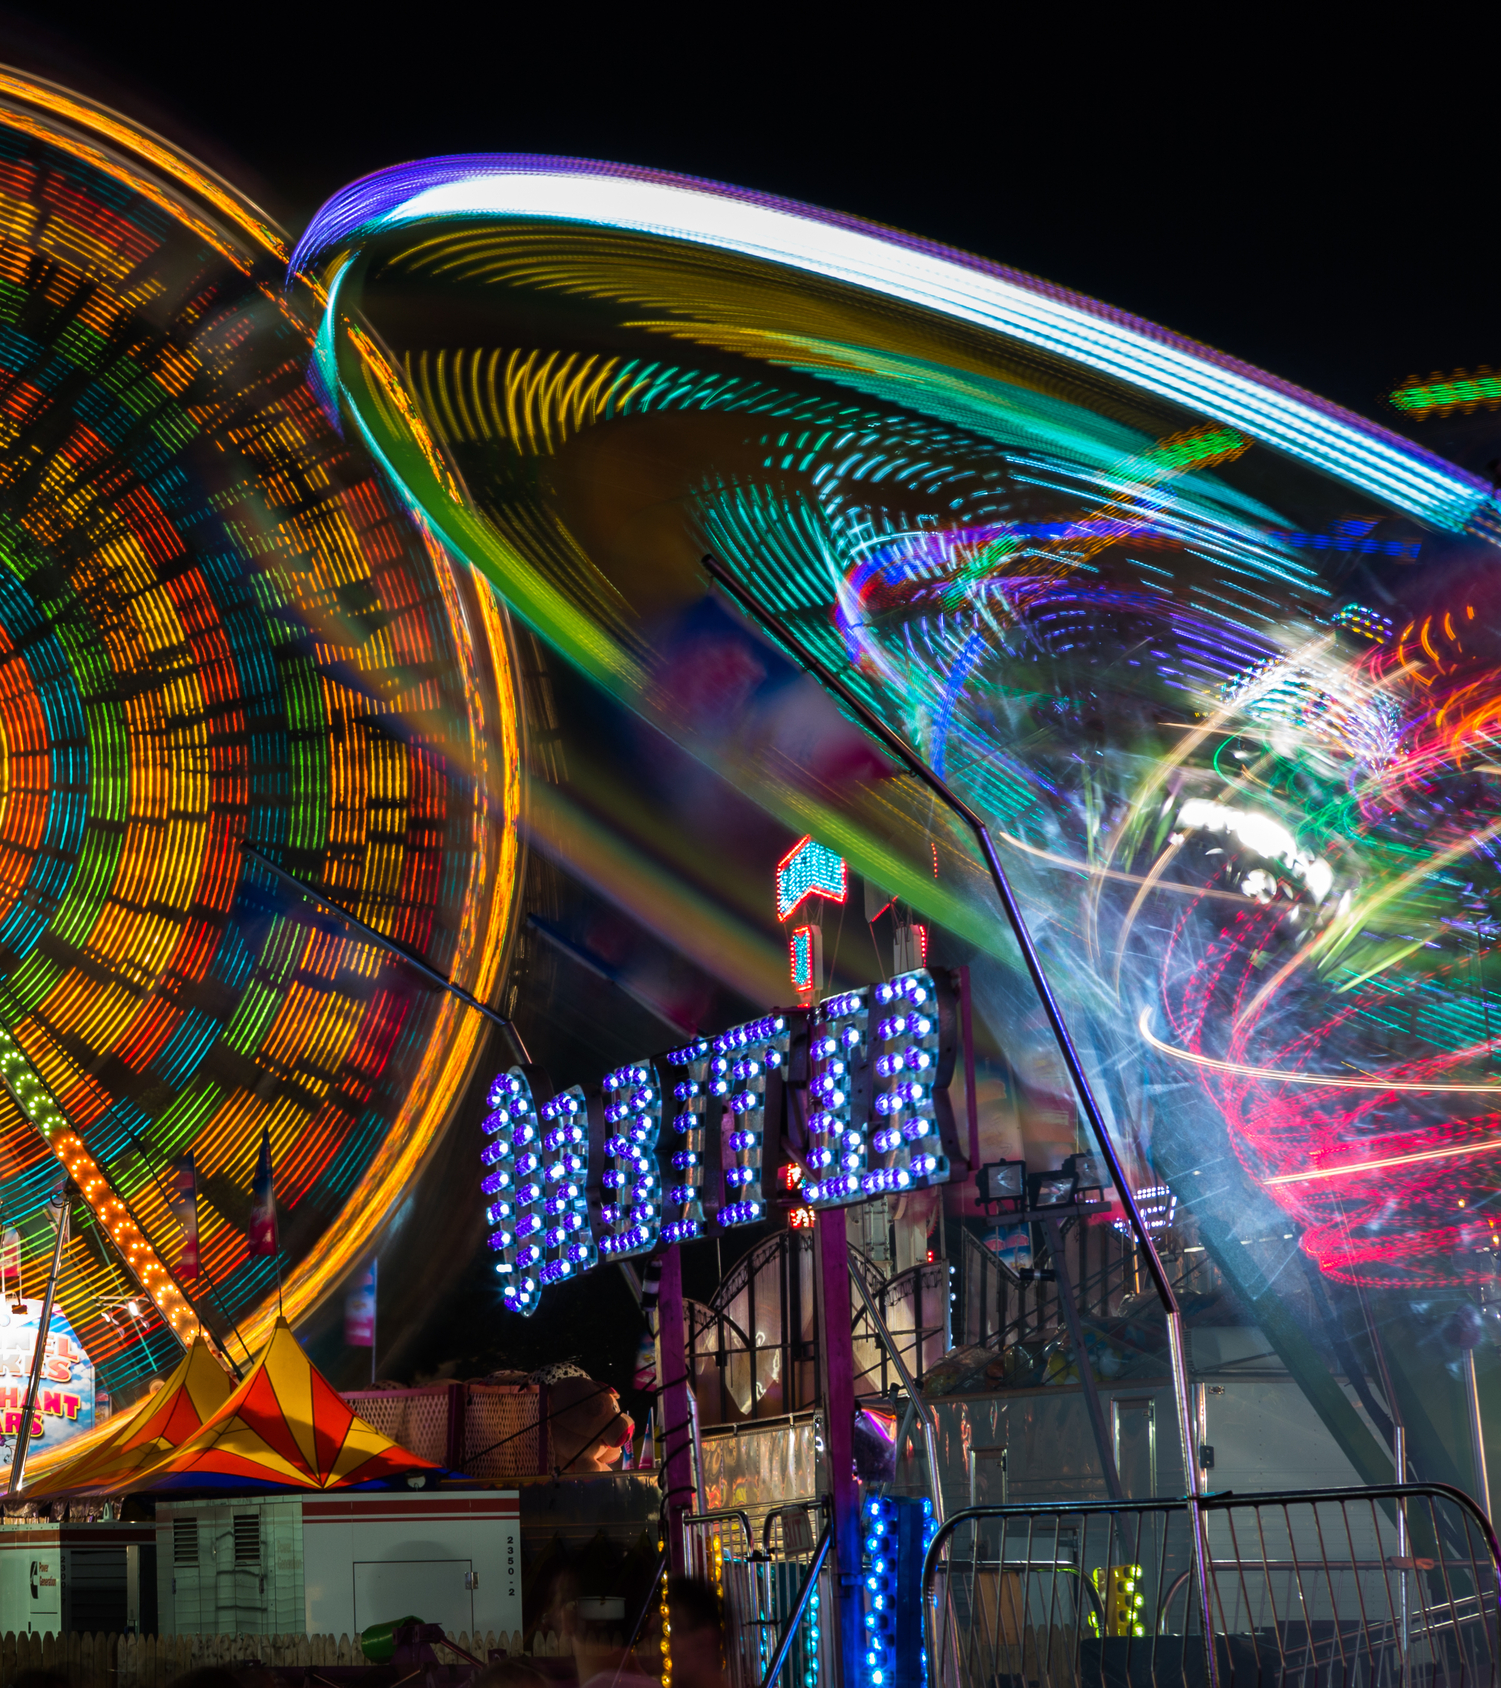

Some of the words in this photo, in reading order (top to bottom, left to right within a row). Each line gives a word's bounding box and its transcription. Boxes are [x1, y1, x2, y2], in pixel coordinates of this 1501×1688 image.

[482, 970, 948, 1316] ORBITER
[783, 1517, 803, 1550] EXIT
[507, 1536, 515, 1597] 2350-2
